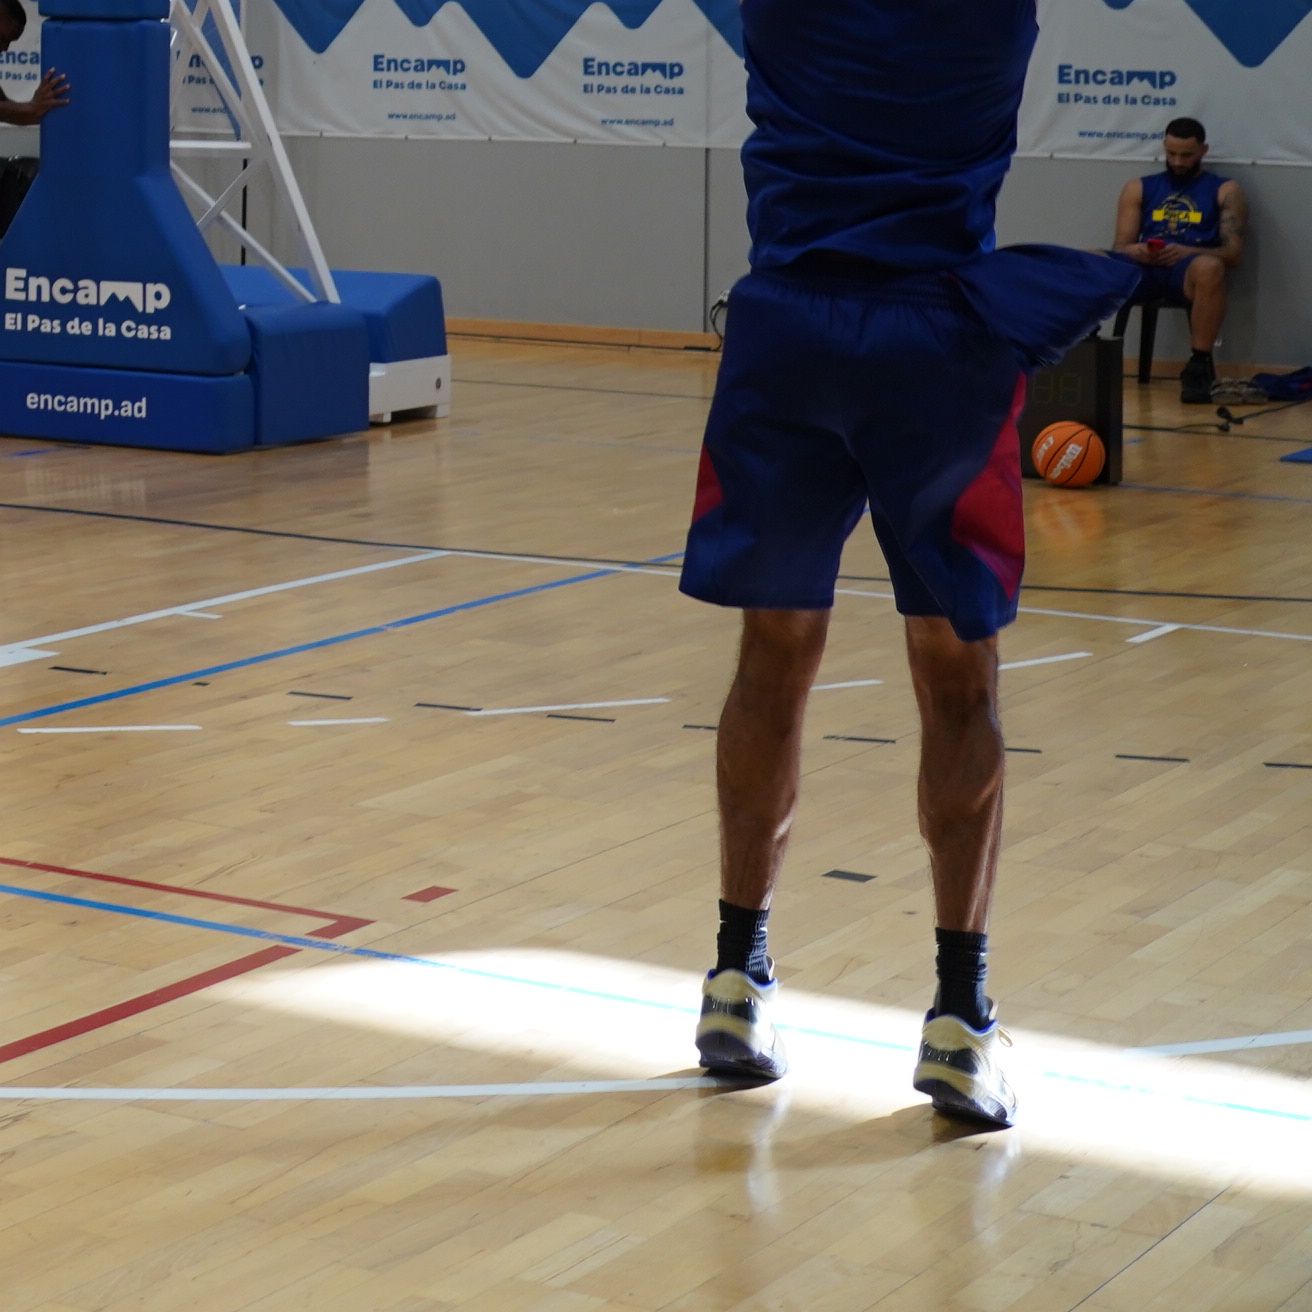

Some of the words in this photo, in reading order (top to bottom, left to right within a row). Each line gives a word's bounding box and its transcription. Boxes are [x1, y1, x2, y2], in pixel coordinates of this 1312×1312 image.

[373, 54, 466, 76] Encamp
[583, 57, 684, 80] Encamp
[5, 71, 23, 81] Pas
[24, 71, 38, 81] de
[1057, 64, 1177, 90] Encamp
[373, 79, 383, 89] El
[386, 80, 405, 89] Pas
[408, 80, 422, 89] de
[426, 80, 436, 90] la
[439, 81, 466, 91] Casa
[583, 83, 593, 94] El
[597, 84, 618, 94] Pas
[621, 84, 636, 94] de
[640, 84, 651, 95] la
[654, 85, 684, 95] Casa
[1057, 93, 1069, 103] El
[1074, 93, 1098, 104] Pas
[1102, 94, 1120, 105] de
[1125, 94, 1138, 105] la
[1141, 95, 1176, 106] Casa
[387, 113, 456, 122] www.encamp.ad
[600, 118, 674, 127] www.encamp.ad
[5, 267, 171, 314] Encamp
[4, 312, 22, 331] El
[27, 314, 61, 334] Pas
[66, 317, 92, 335] de
[98, 318, 117, 337] la
[120, 320, 172, 340] Casa
[26, 392, 147, 420] encamp.ad
